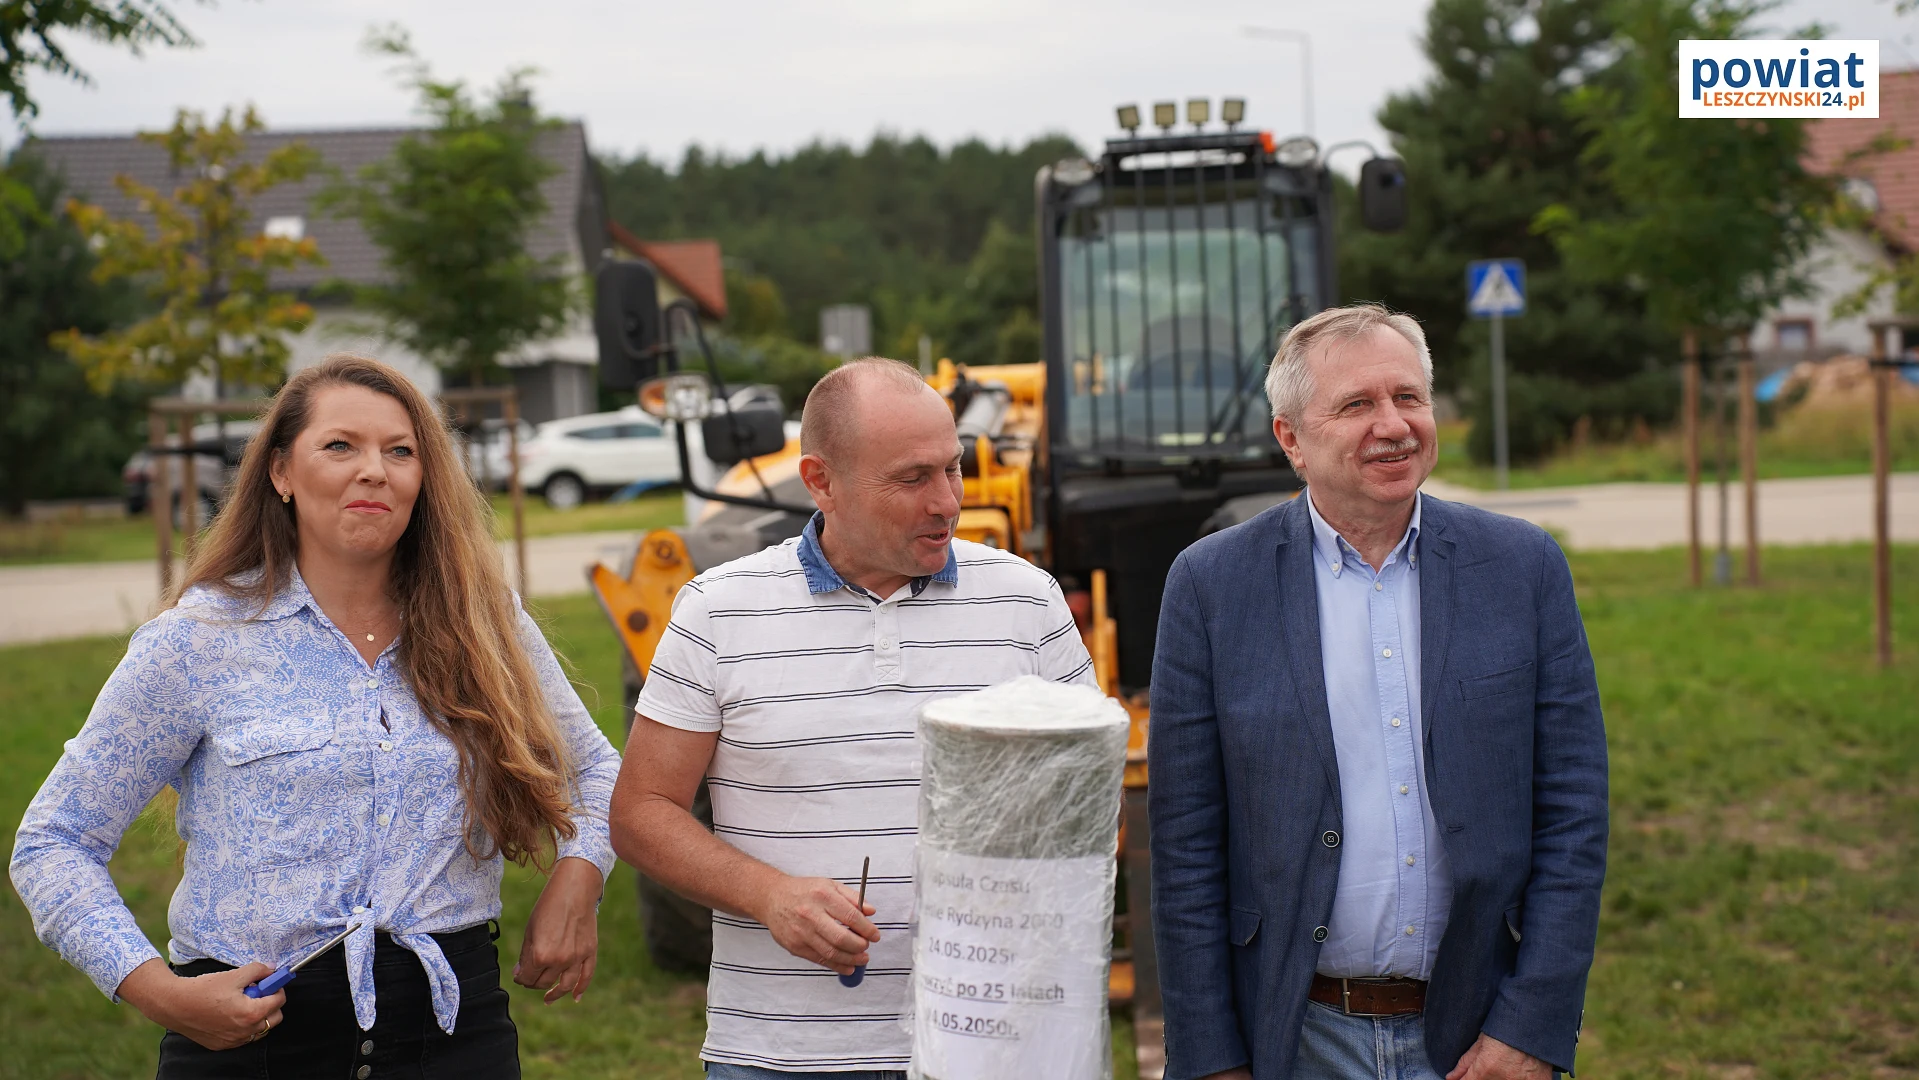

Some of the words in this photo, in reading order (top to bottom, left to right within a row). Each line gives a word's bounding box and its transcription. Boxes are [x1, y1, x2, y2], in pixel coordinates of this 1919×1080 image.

[979, 875, 1031, 894] Czasu
[947, 906, 1014, 932] Rydzyna
[957, 983, 977, 998] po
[983, 982, 1004, 999] 25
[1010, 983, 1064, 1000] latach
